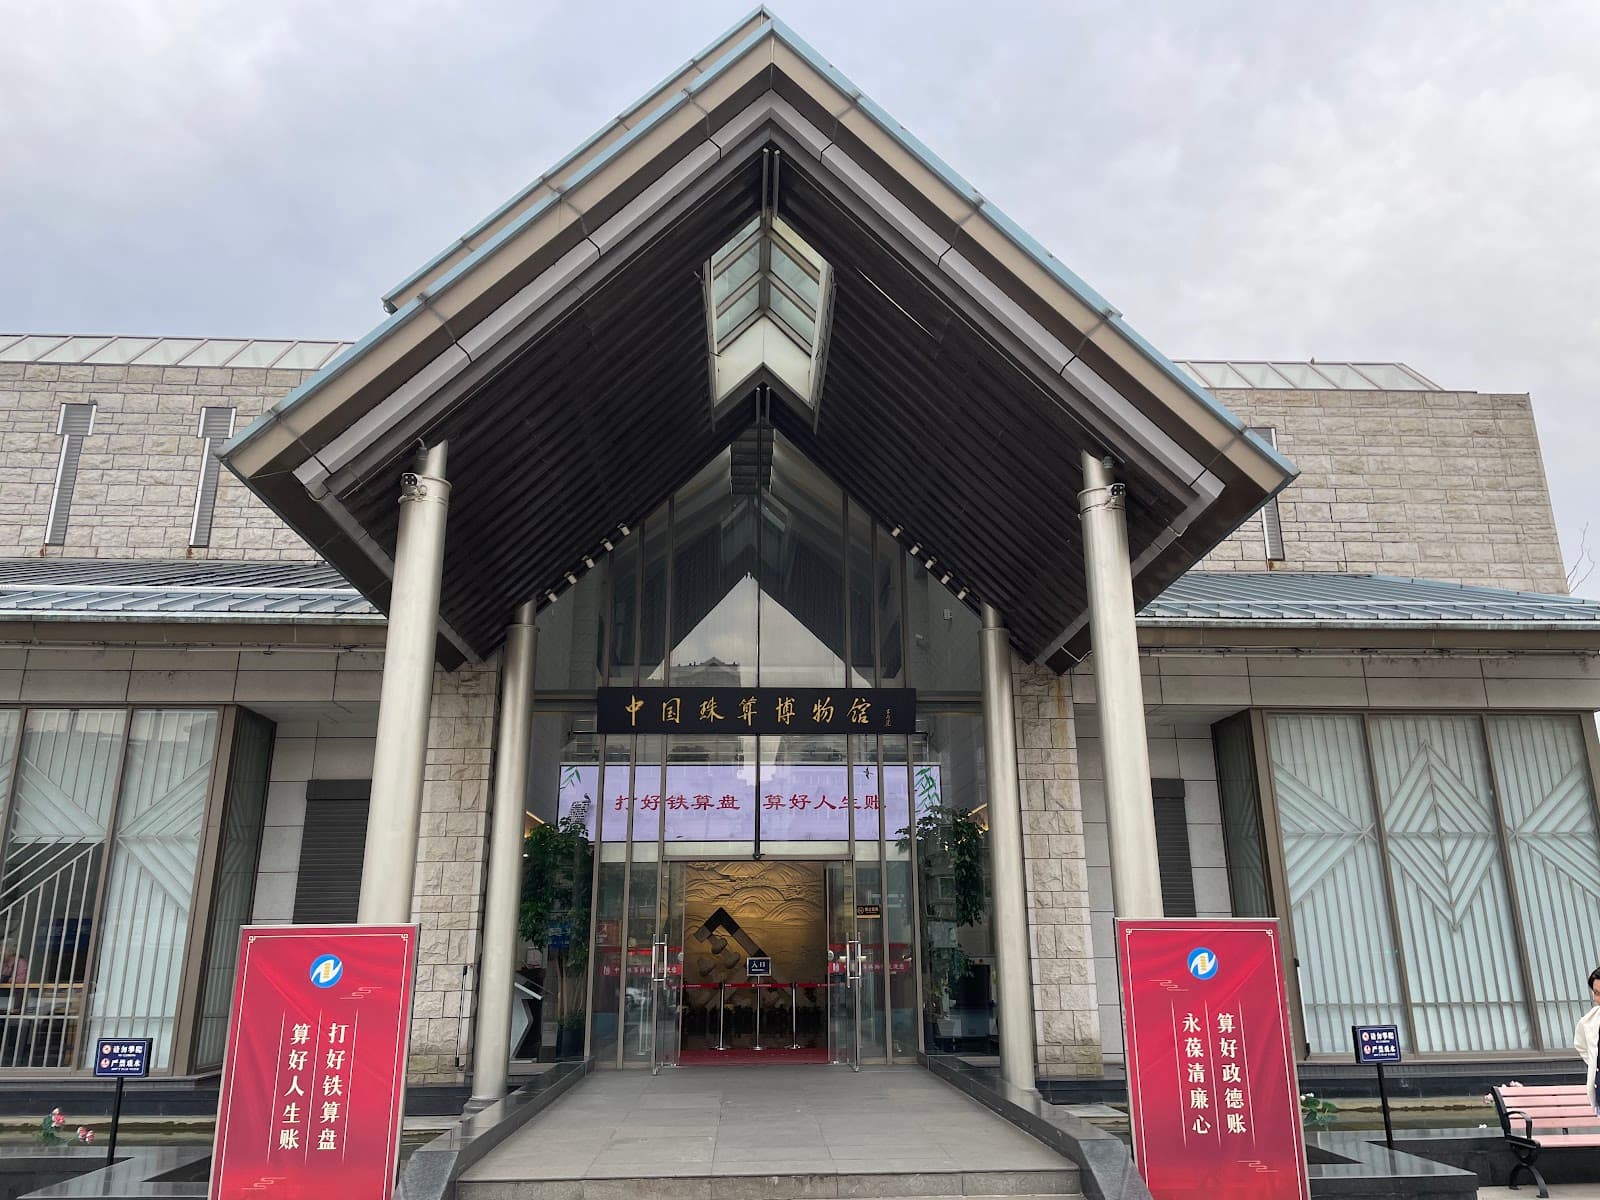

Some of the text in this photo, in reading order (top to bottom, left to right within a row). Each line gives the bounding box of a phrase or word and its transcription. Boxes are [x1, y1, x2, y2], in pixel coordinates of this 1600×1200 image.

[624, 694, 872, 727] 中国珠算博物馆
[751, 960, 766, 969] 入口
[278, 1023, 312, 1151] 算好人生账
[316, 1022, 349, 1151] 打好铁算盘
[1182, 1012, 1211, 1135] 永葆清廉心
[1216, 1012, 1247, 1135] 算好政德账
